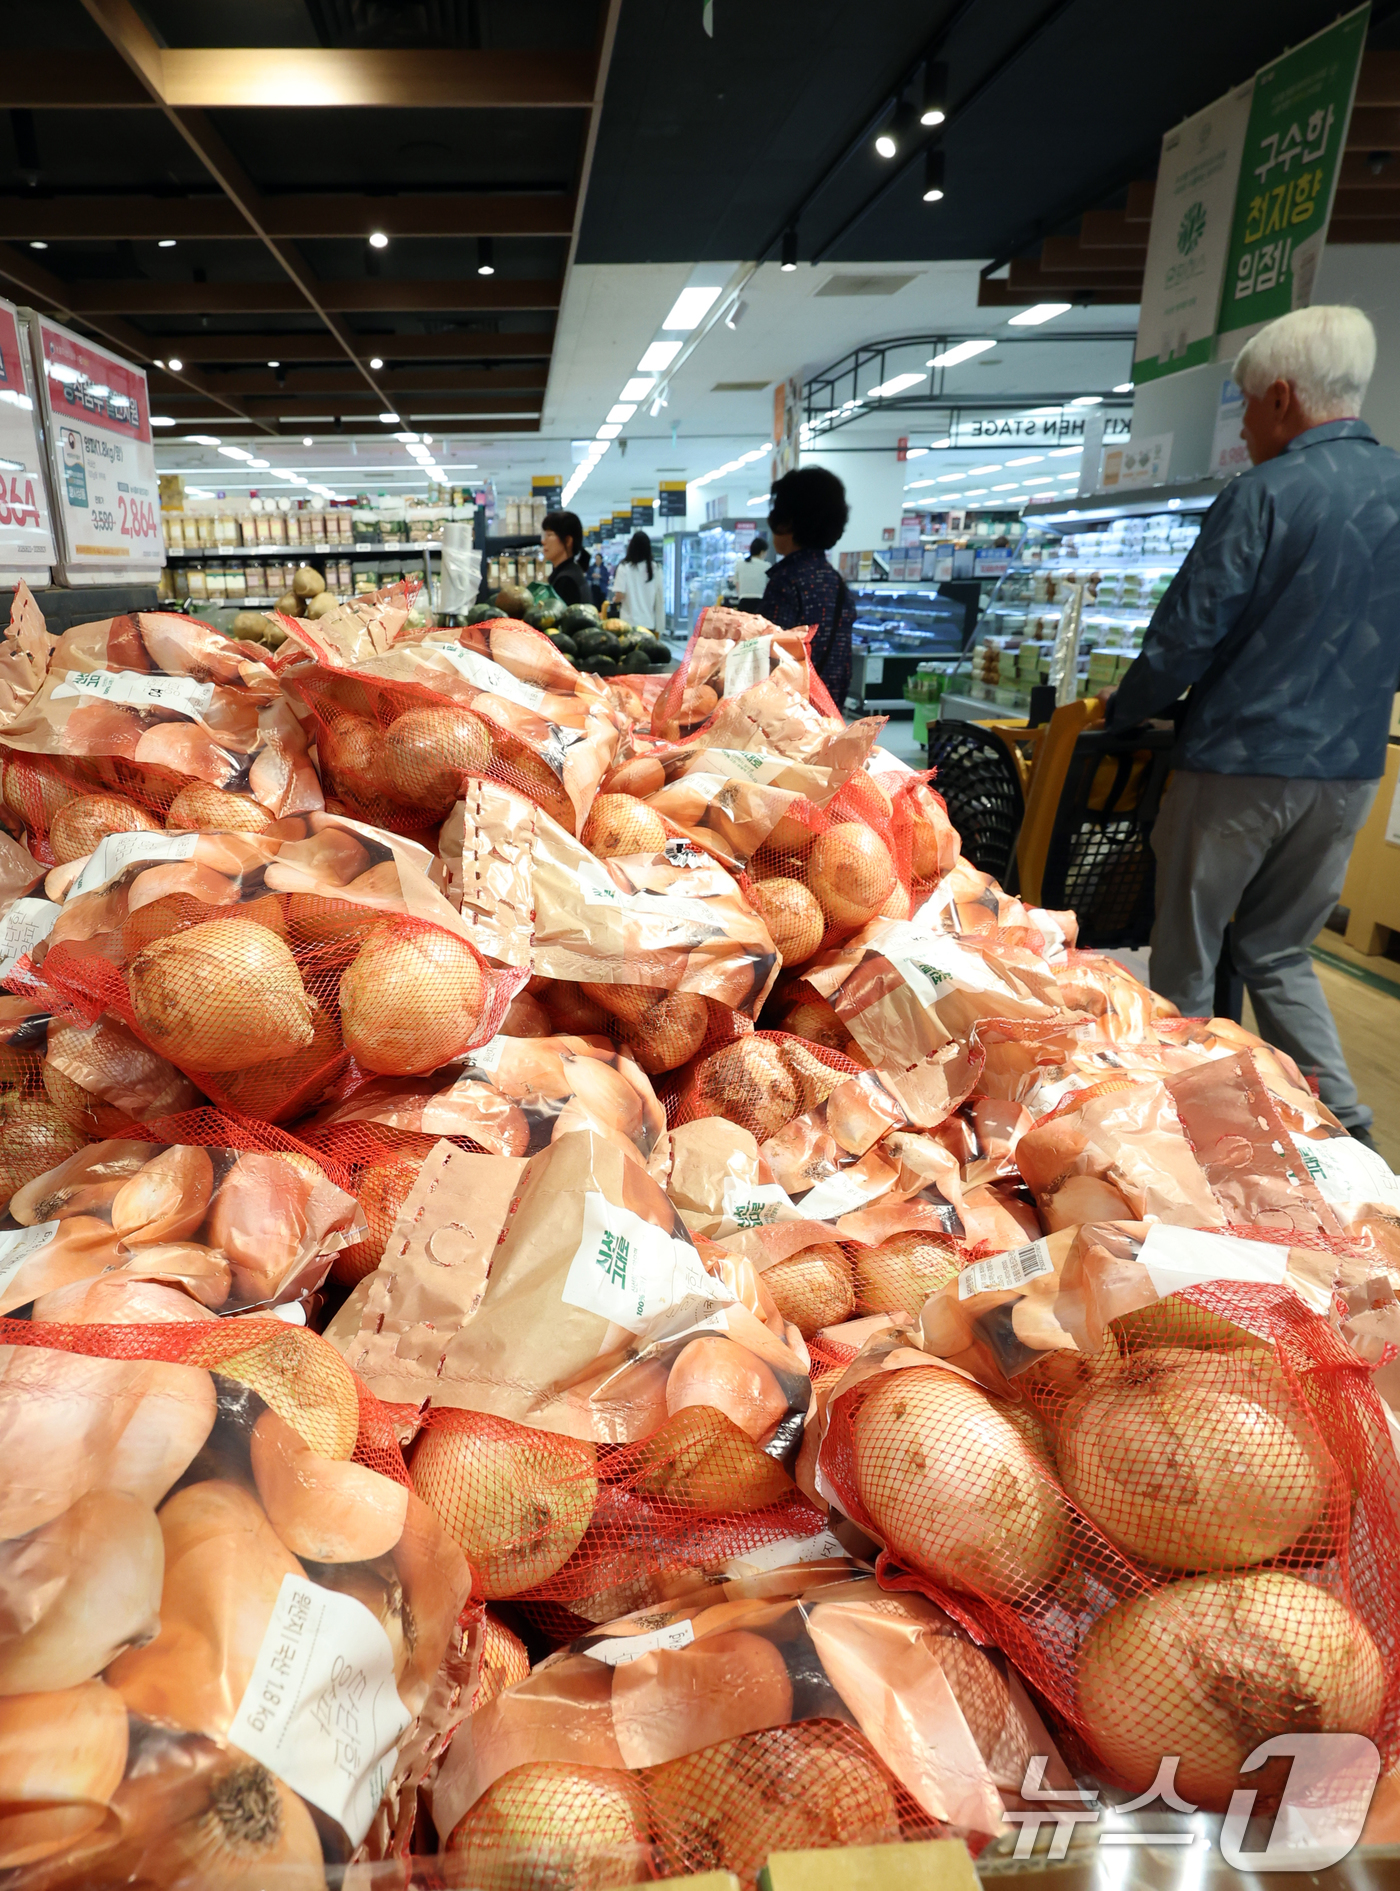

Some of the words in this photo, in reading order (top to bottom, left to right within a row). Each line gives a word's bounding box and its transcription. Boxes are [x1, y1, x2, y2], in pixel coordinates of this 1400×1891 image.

[1254, 103, 1335, 184] 구수한
[1244, 168, 1323, 244] 천지향
[1234, 237, 1292, 300] 입점!
[92, 509, 115, 532] 3,580
[118, 495, 158, 539] 2,864
[148, 687, 163, 698] CA
[1298, 1146, 1328, 1181] 그대로
[595, 1229, 618, 1275] 신선
[611, 1235, 631, 1291] 그대로
[636, 1294, 647, 1317] 100%
[284, 1590, 312, 1637] 원산지
[270, 1645, 297, 1678] 국산
[310, 1654, 353, 1737] 양파
[335, 1668, 367, 1781] 단단한
